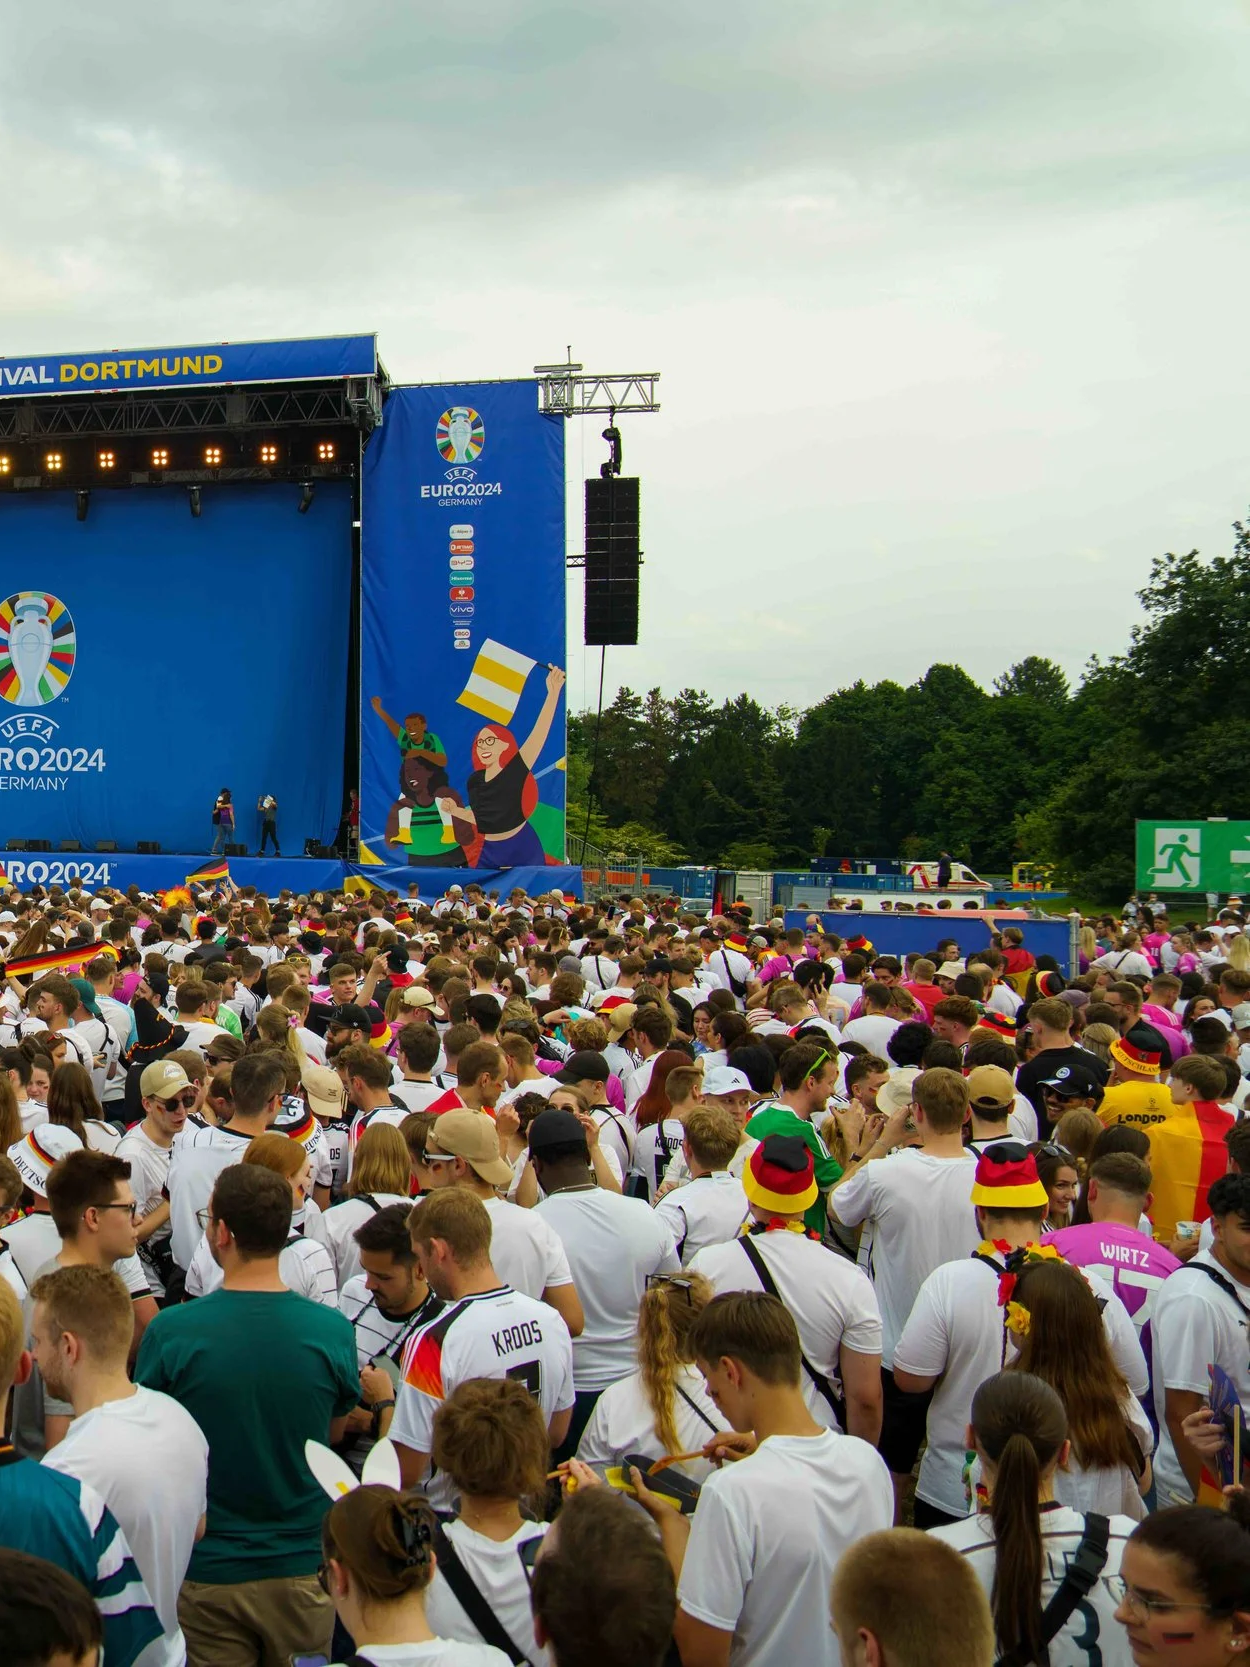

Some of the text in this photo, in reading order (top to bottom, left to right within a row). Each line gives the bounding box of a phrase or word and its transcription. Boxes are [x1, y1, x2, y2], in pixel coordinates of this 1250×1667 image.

[60, 355, 223, 383] DORTMUND
[446, 469, 474, 480] UEFA
[420, 482, 502, 498] EURO2024
[438, 498, 483, 507] GERMANY
[1, 718, 54, 740] UEFA
[1100, 1241, 1150, 1268] WIRTZ
[492, 1319, 543, 1357] KROOS
